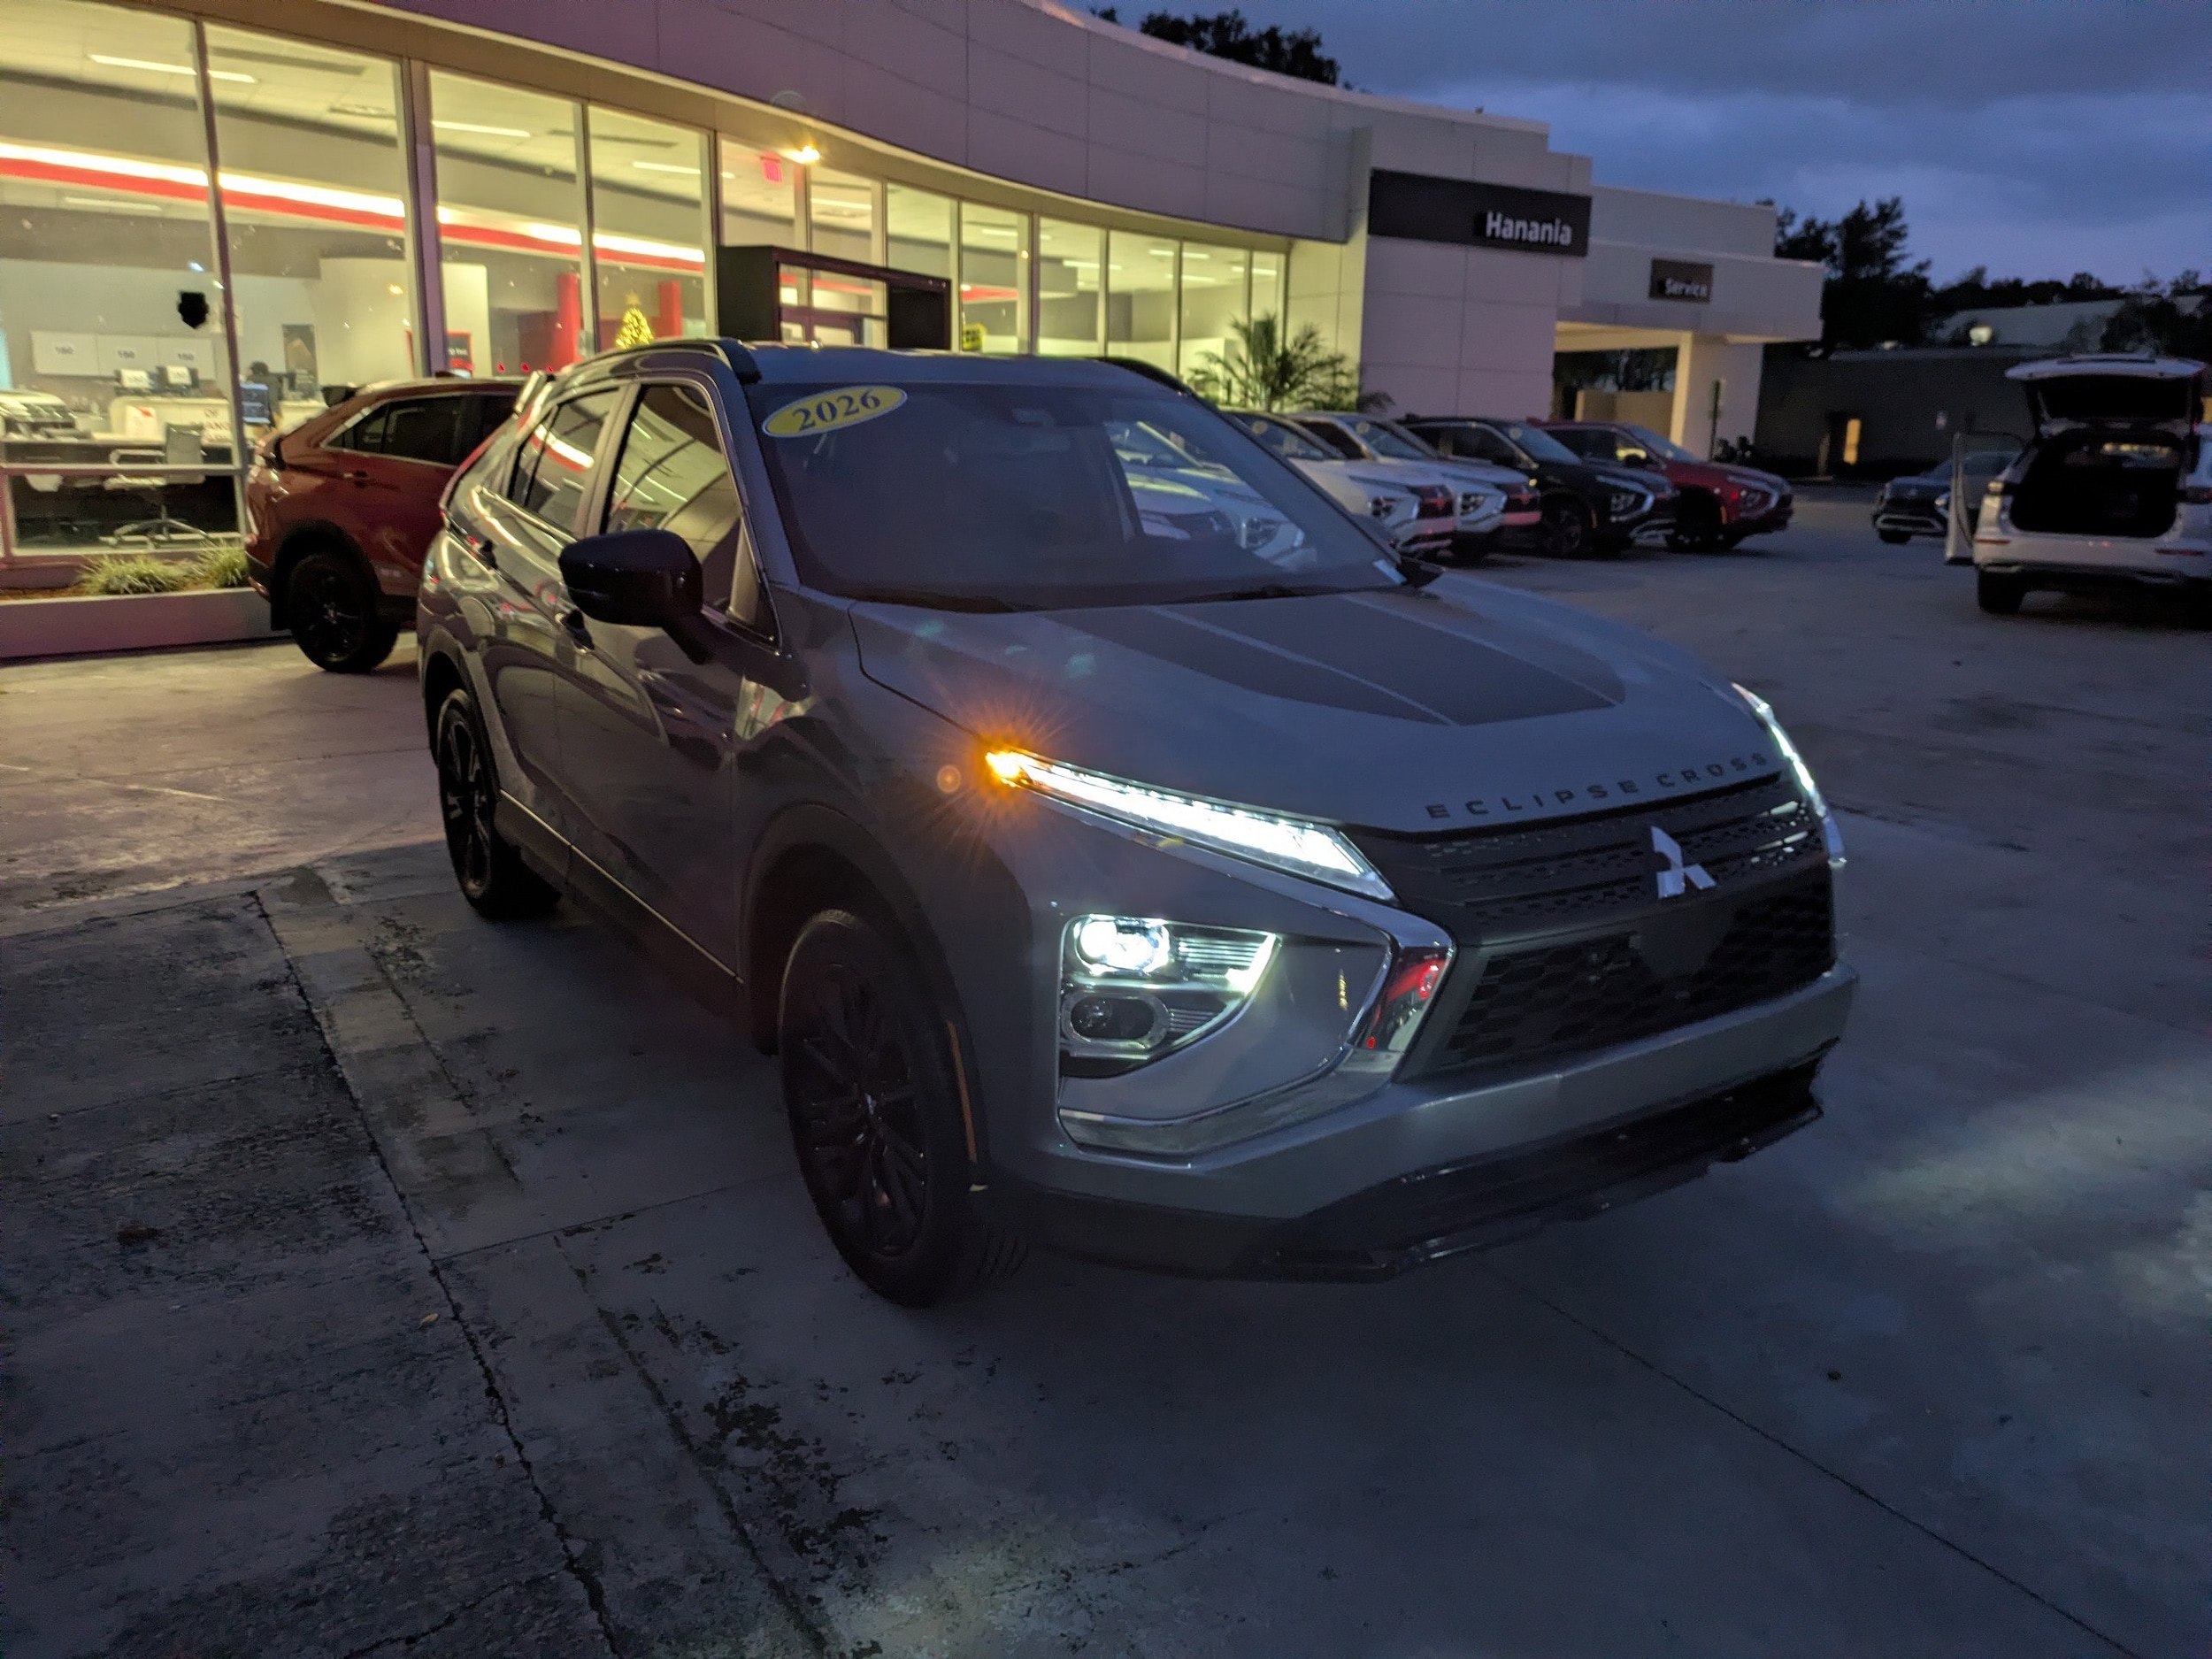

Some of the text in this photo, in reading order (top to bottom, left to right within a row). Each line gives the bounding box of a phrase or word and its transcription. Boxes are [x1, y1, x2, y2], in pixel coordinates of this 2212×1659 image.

[1486, 211, 1572, 246] Hanania
[1664, 278, 1708, 297] Service
[792, 389, 880, 431] 2026
[1425, 752, 1768, 819] ECLIPSE CROSS
